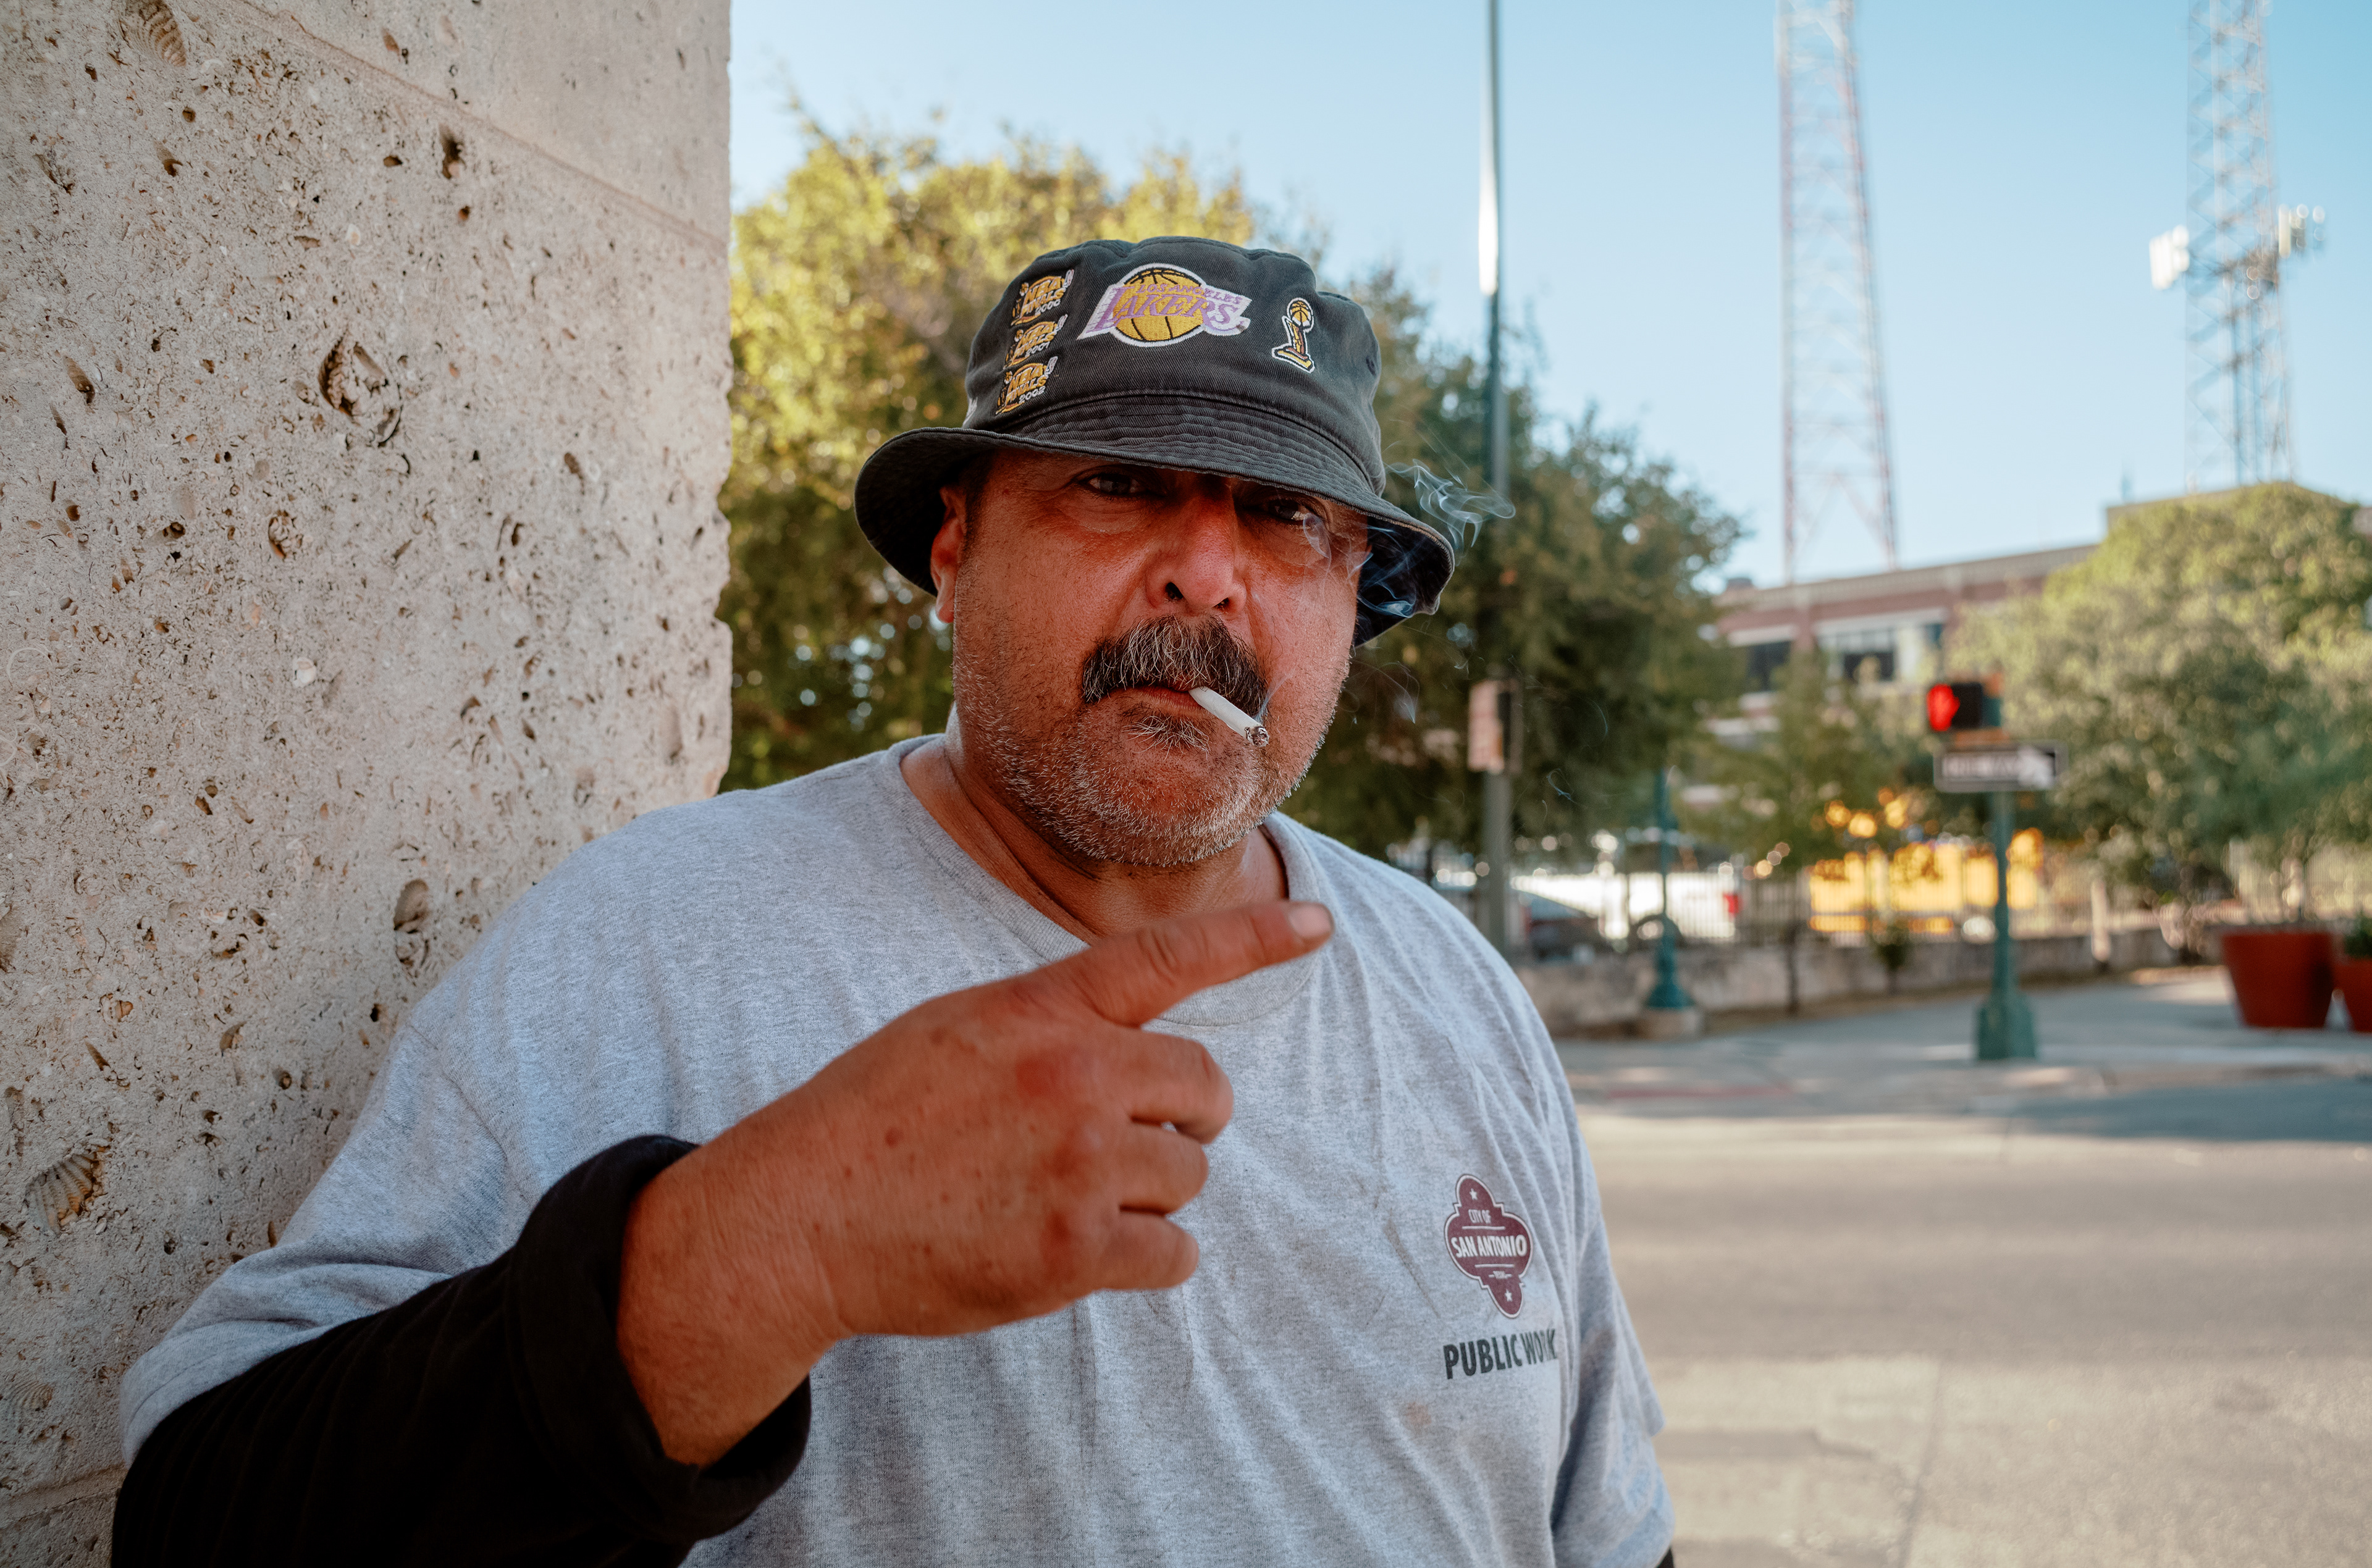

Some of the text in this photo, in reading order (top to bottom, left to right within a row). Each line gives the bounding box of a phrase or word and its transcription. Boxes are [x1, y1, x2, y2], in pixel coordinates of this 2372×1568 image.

[1023, 276, 1062, 306] NBA
[1136, 283, 1243, 305] LOS ANGELES
[1086, 286, 1243, 333] LAKERS
[1025, 342, 1050, 358] 2001
[1007, 363, 1043, 395] NBA
[1450, 1234, 1528, 1257] SAN ANTONIO
[1443, 1334, 1522, 1380] PUBLIC
